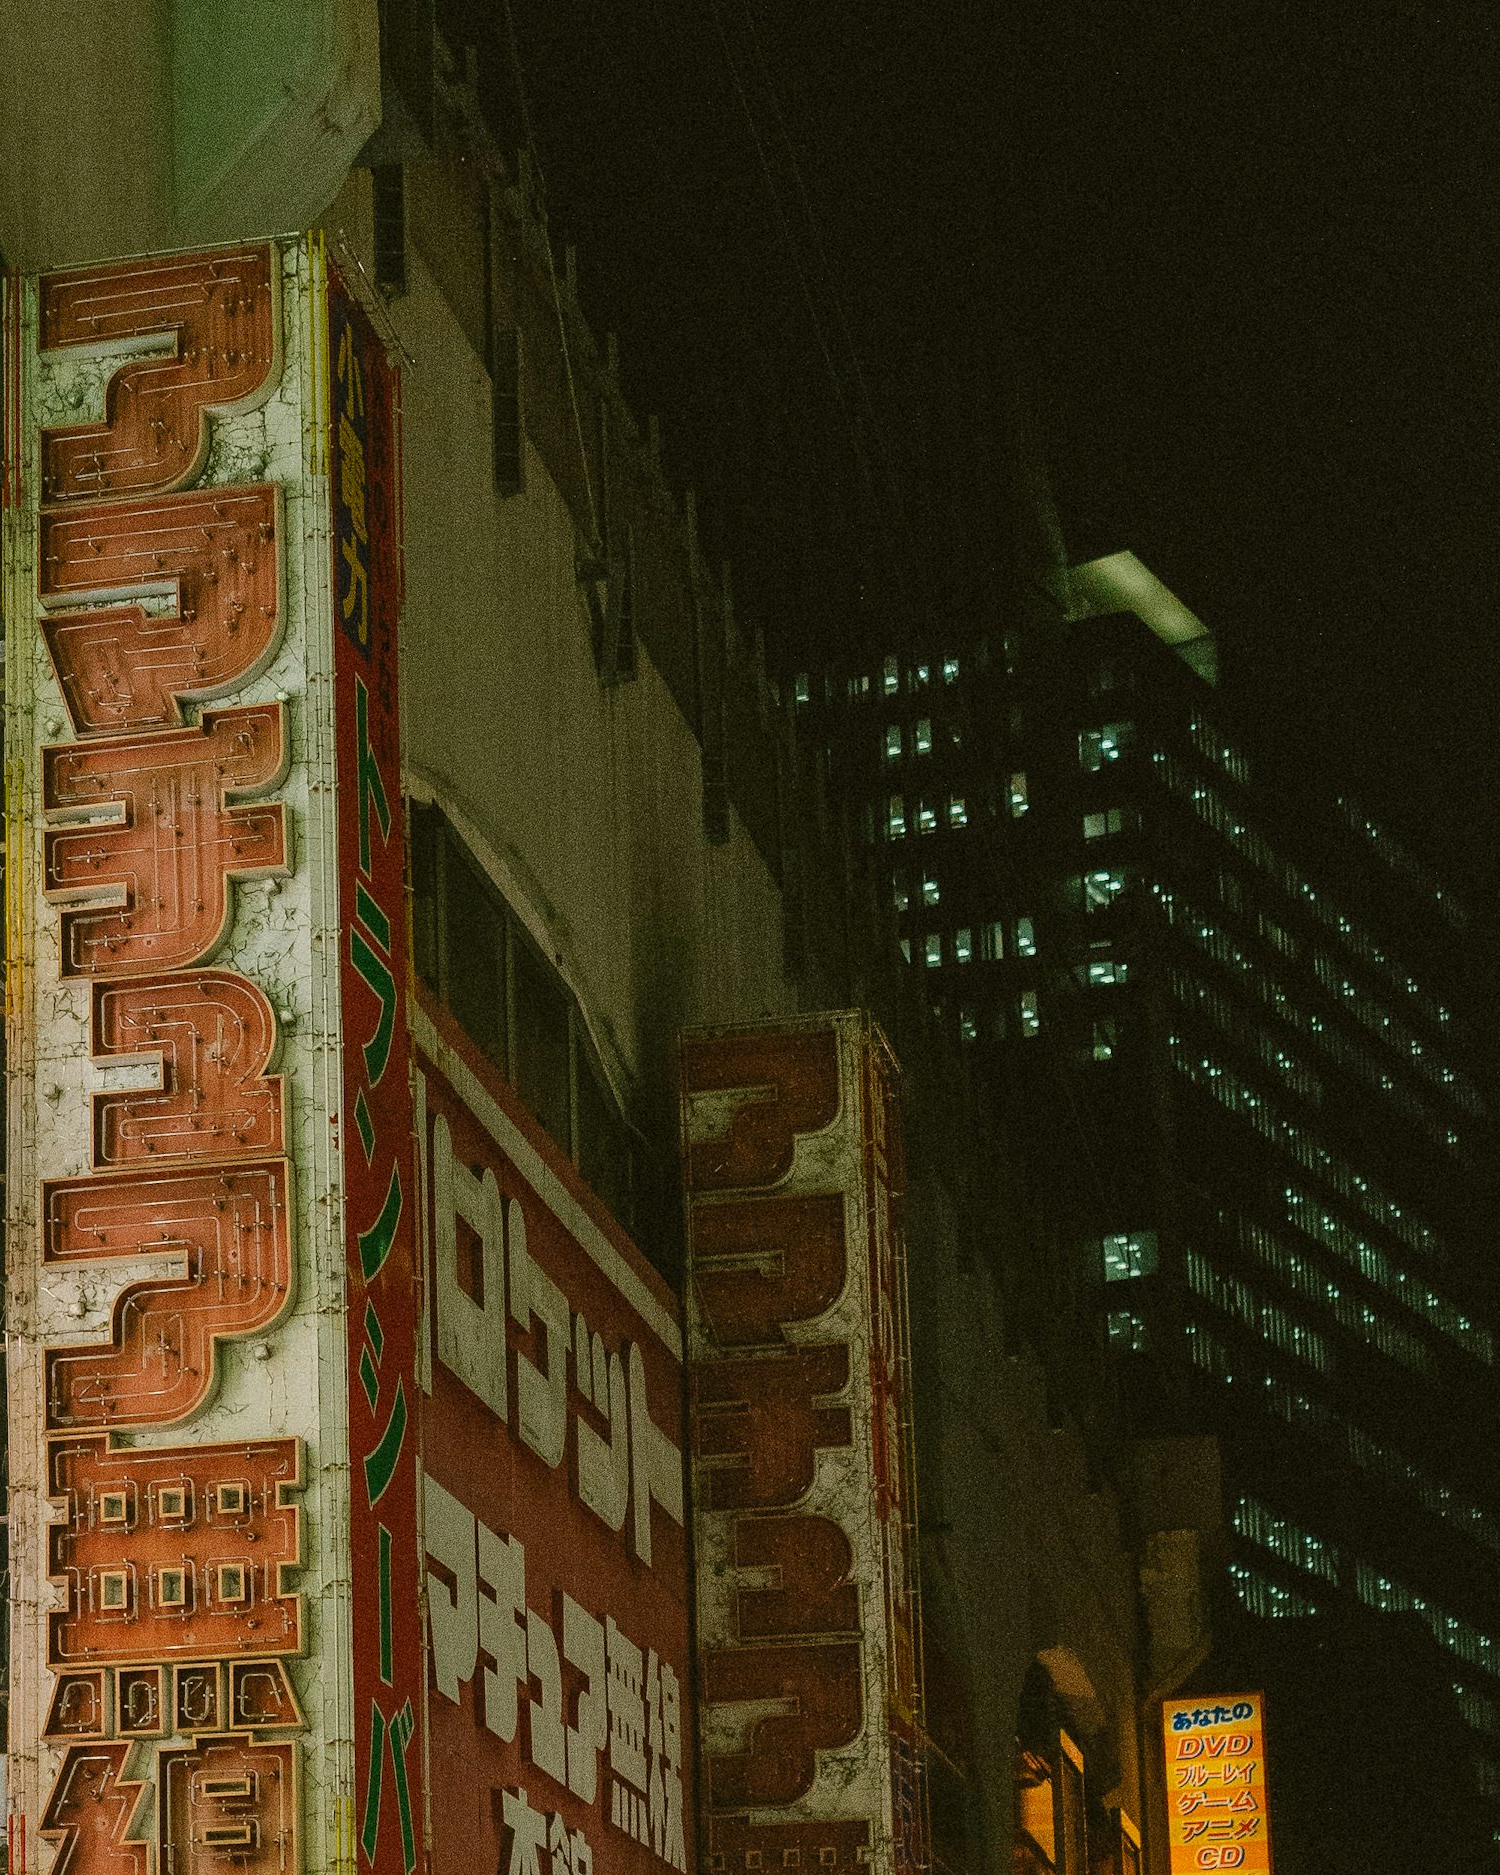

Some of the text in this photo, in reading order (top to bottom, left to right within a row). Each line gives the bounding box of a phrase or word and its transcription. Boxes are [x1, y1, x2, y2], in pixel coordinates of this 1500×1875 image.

[434, 1111, 684, 1571] ロケット
[1172, 1701, 1255, 1732] あなたの
[1176, 1734, 1253, 1760] DVD
[1177, 1790, 1258, 1816] ゲーム
[1181, 1817, 1261, 1843] アニメ
[1195, 1845, 1245, 1870] CD
